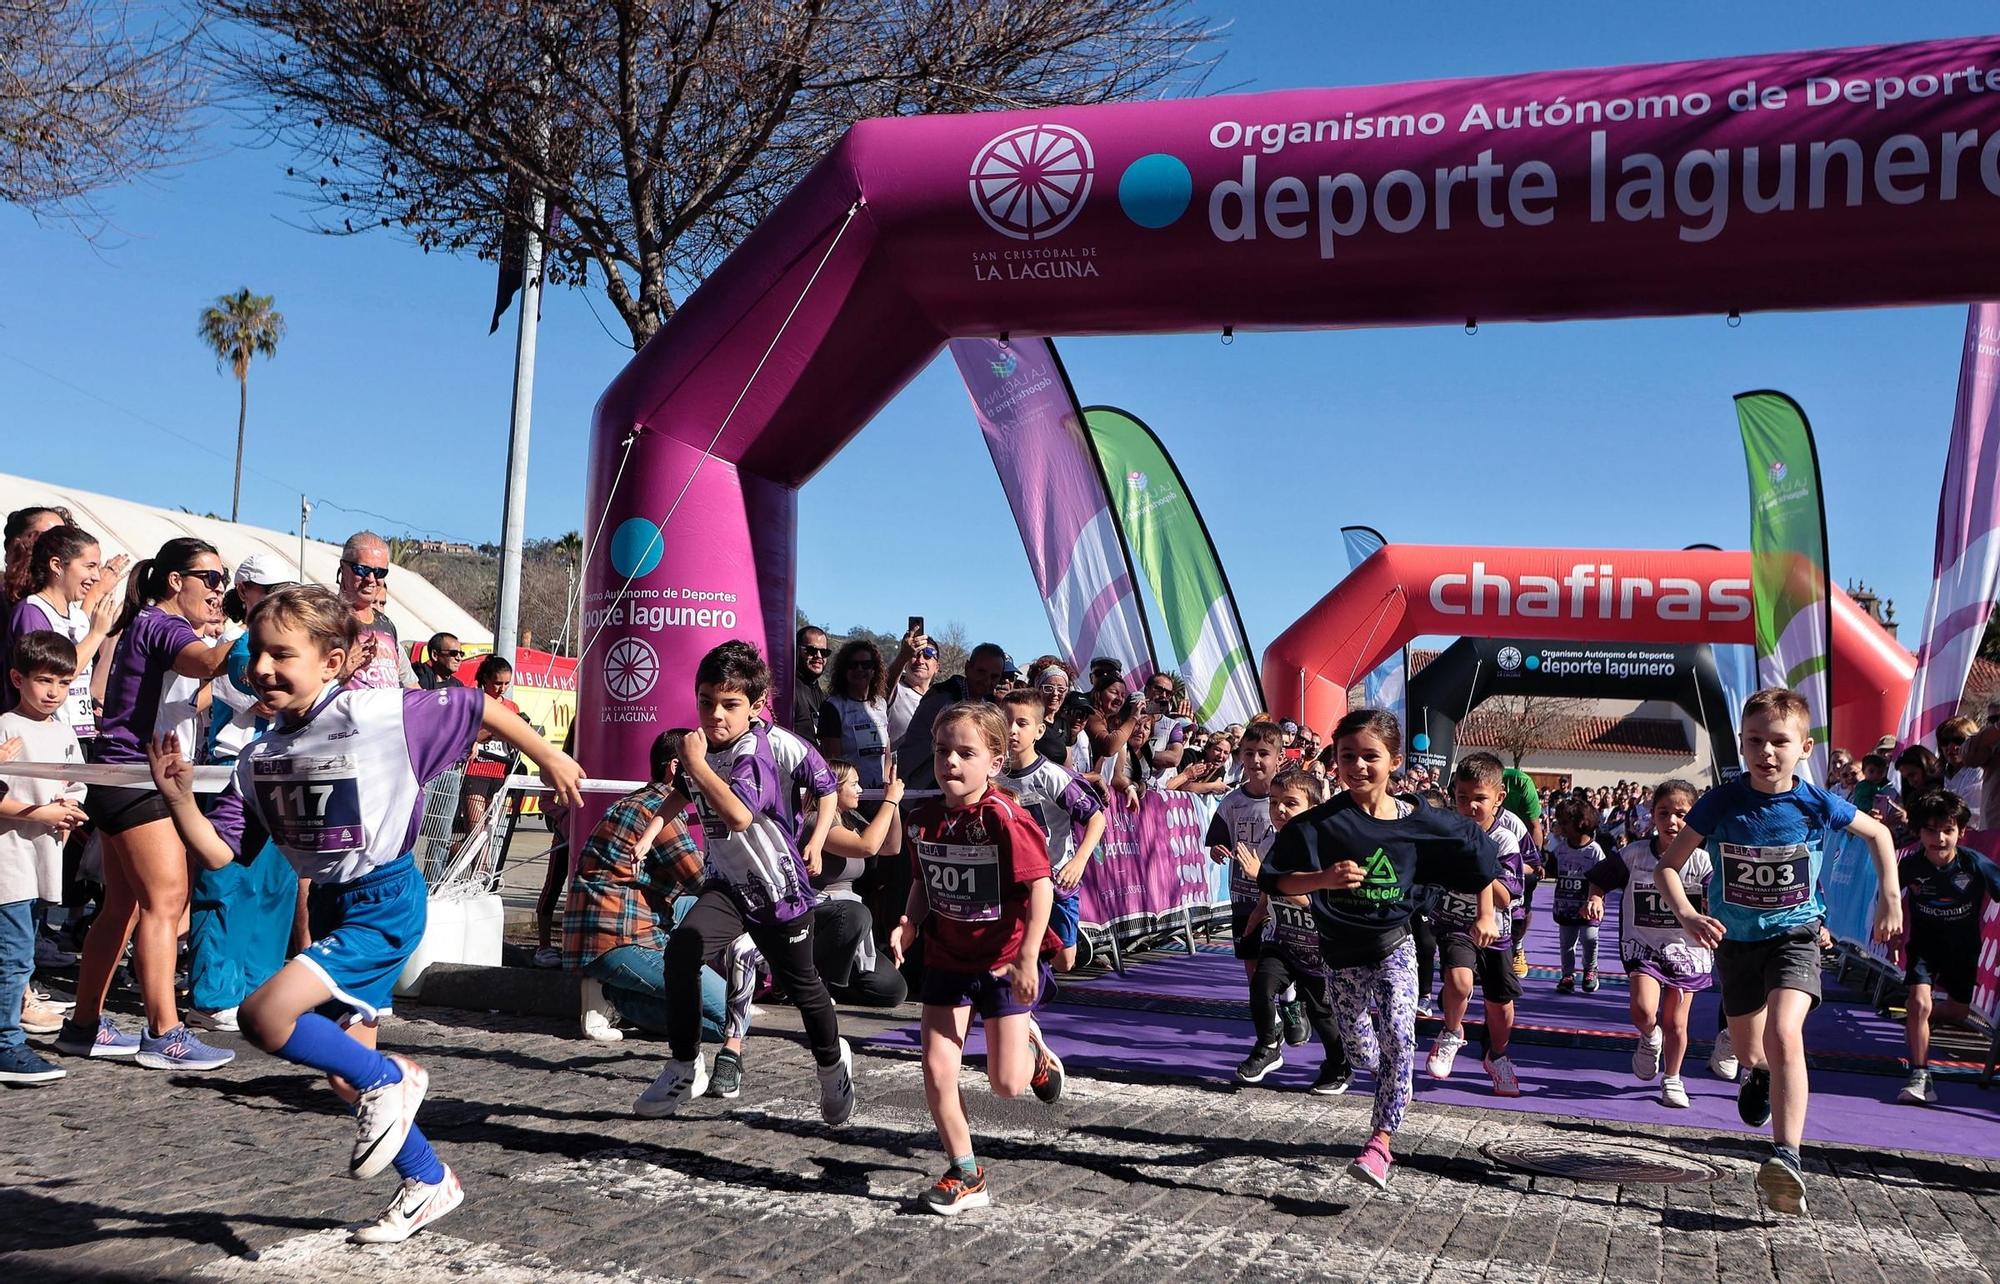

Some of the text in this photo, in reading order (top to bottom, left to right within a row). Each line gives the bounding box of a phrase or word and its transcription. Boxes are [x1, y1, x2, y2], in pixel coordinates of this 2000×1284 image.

[1209, 110, 1445, 154] Organismo
[1459, 88, 1712, 136] Autónomo
[1728, 81, 1788, 112] de
[1208, 149, 1558, 259] deporte
[972, 247, 1097, 261] SAN CRISTÓBAL DE
[975, 261, 1099, 281] LA LAGUNA
[663, 587, 678, 599] de
[682, 588, 737, 602] Deportes
[1429, 562, 1750, 621] chafiras
[630, 600, 737, 631] lagunero
[1541, 648, 1674, 661] Organismo Autónomo de Deportes
[1541, 658, 1675, 678] deporte lagunero
[601, 712, 657, 722] LA LAGUNA
[270, 785, 334, 816] 117
[928, 864, 976, 893] 201
[1560, 880, 1582, 890] 108
[1737, 863, 1795, 886] 203
[1443, 895, 1477, 918] 123
[1283, 908, 1316, 929] 115
